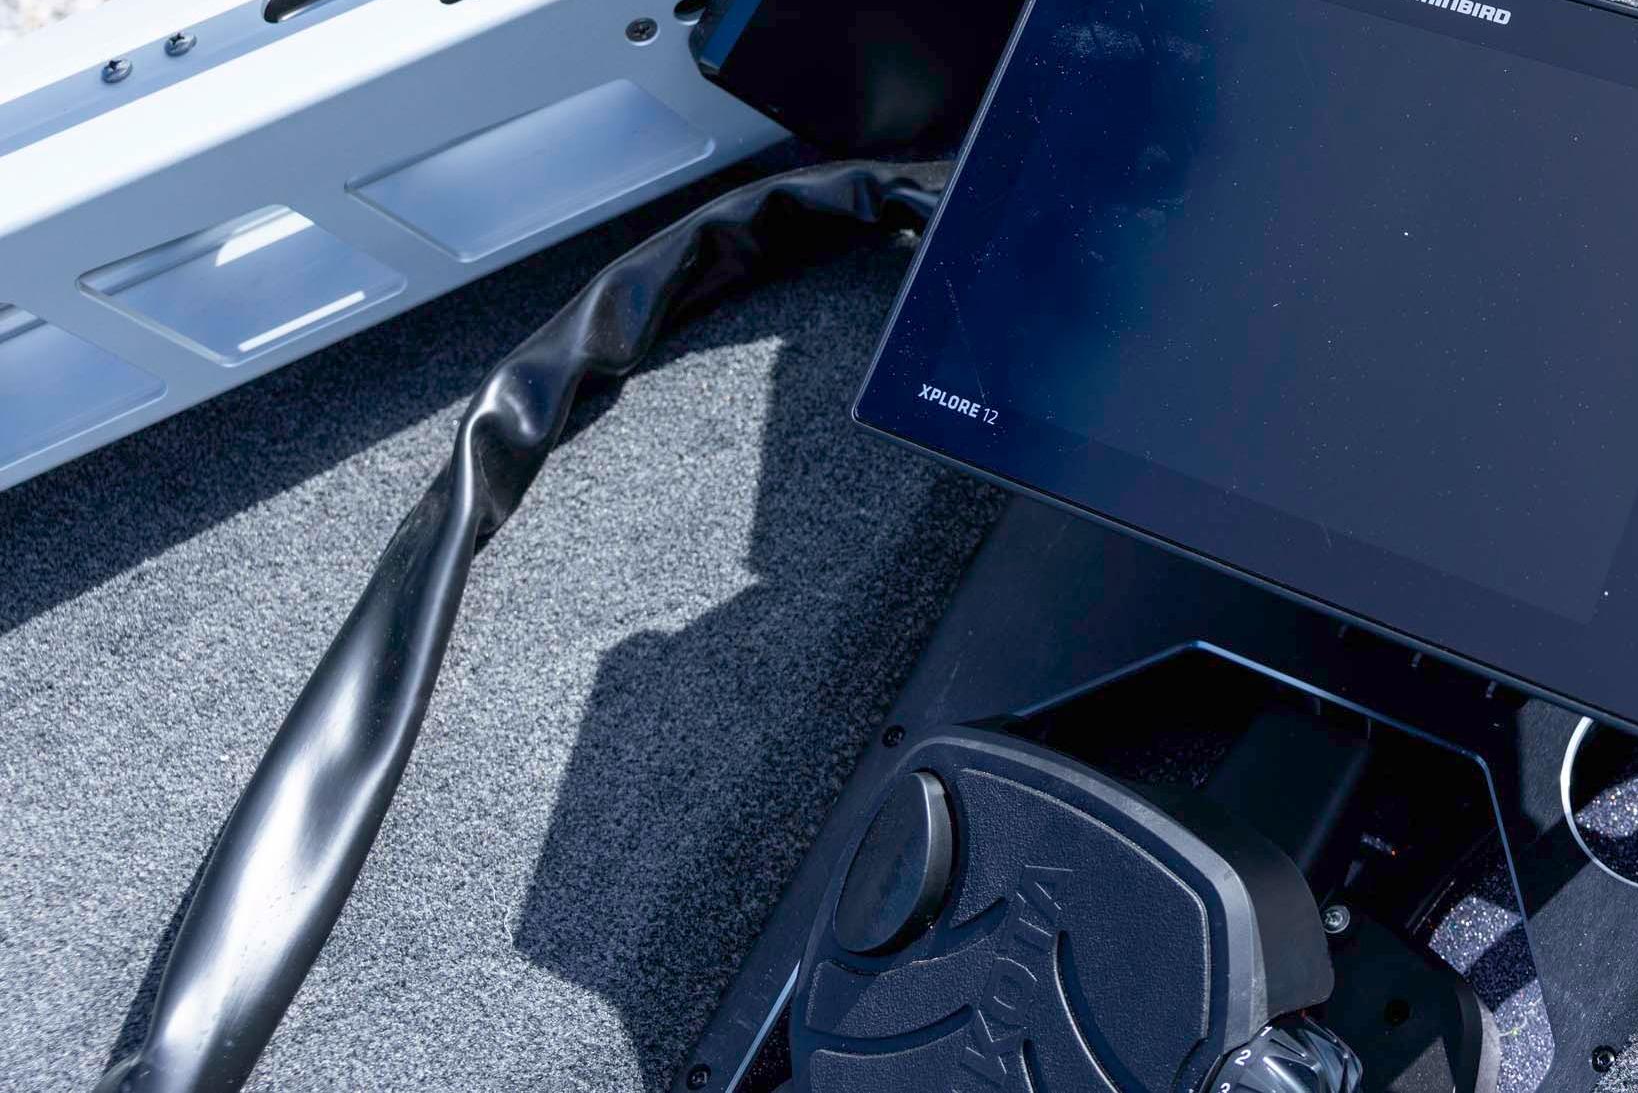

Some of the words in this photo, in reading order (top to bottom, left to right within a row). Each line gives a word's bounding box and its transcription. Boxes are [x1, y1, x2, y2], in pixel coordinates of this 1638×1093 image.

[918, 383, 981, 418] XPLORE
[983, 408, 999, 425] 12
[1260, 1026, 1273, 1037] 1
[1235, 1049, 1252, 1066] 2
